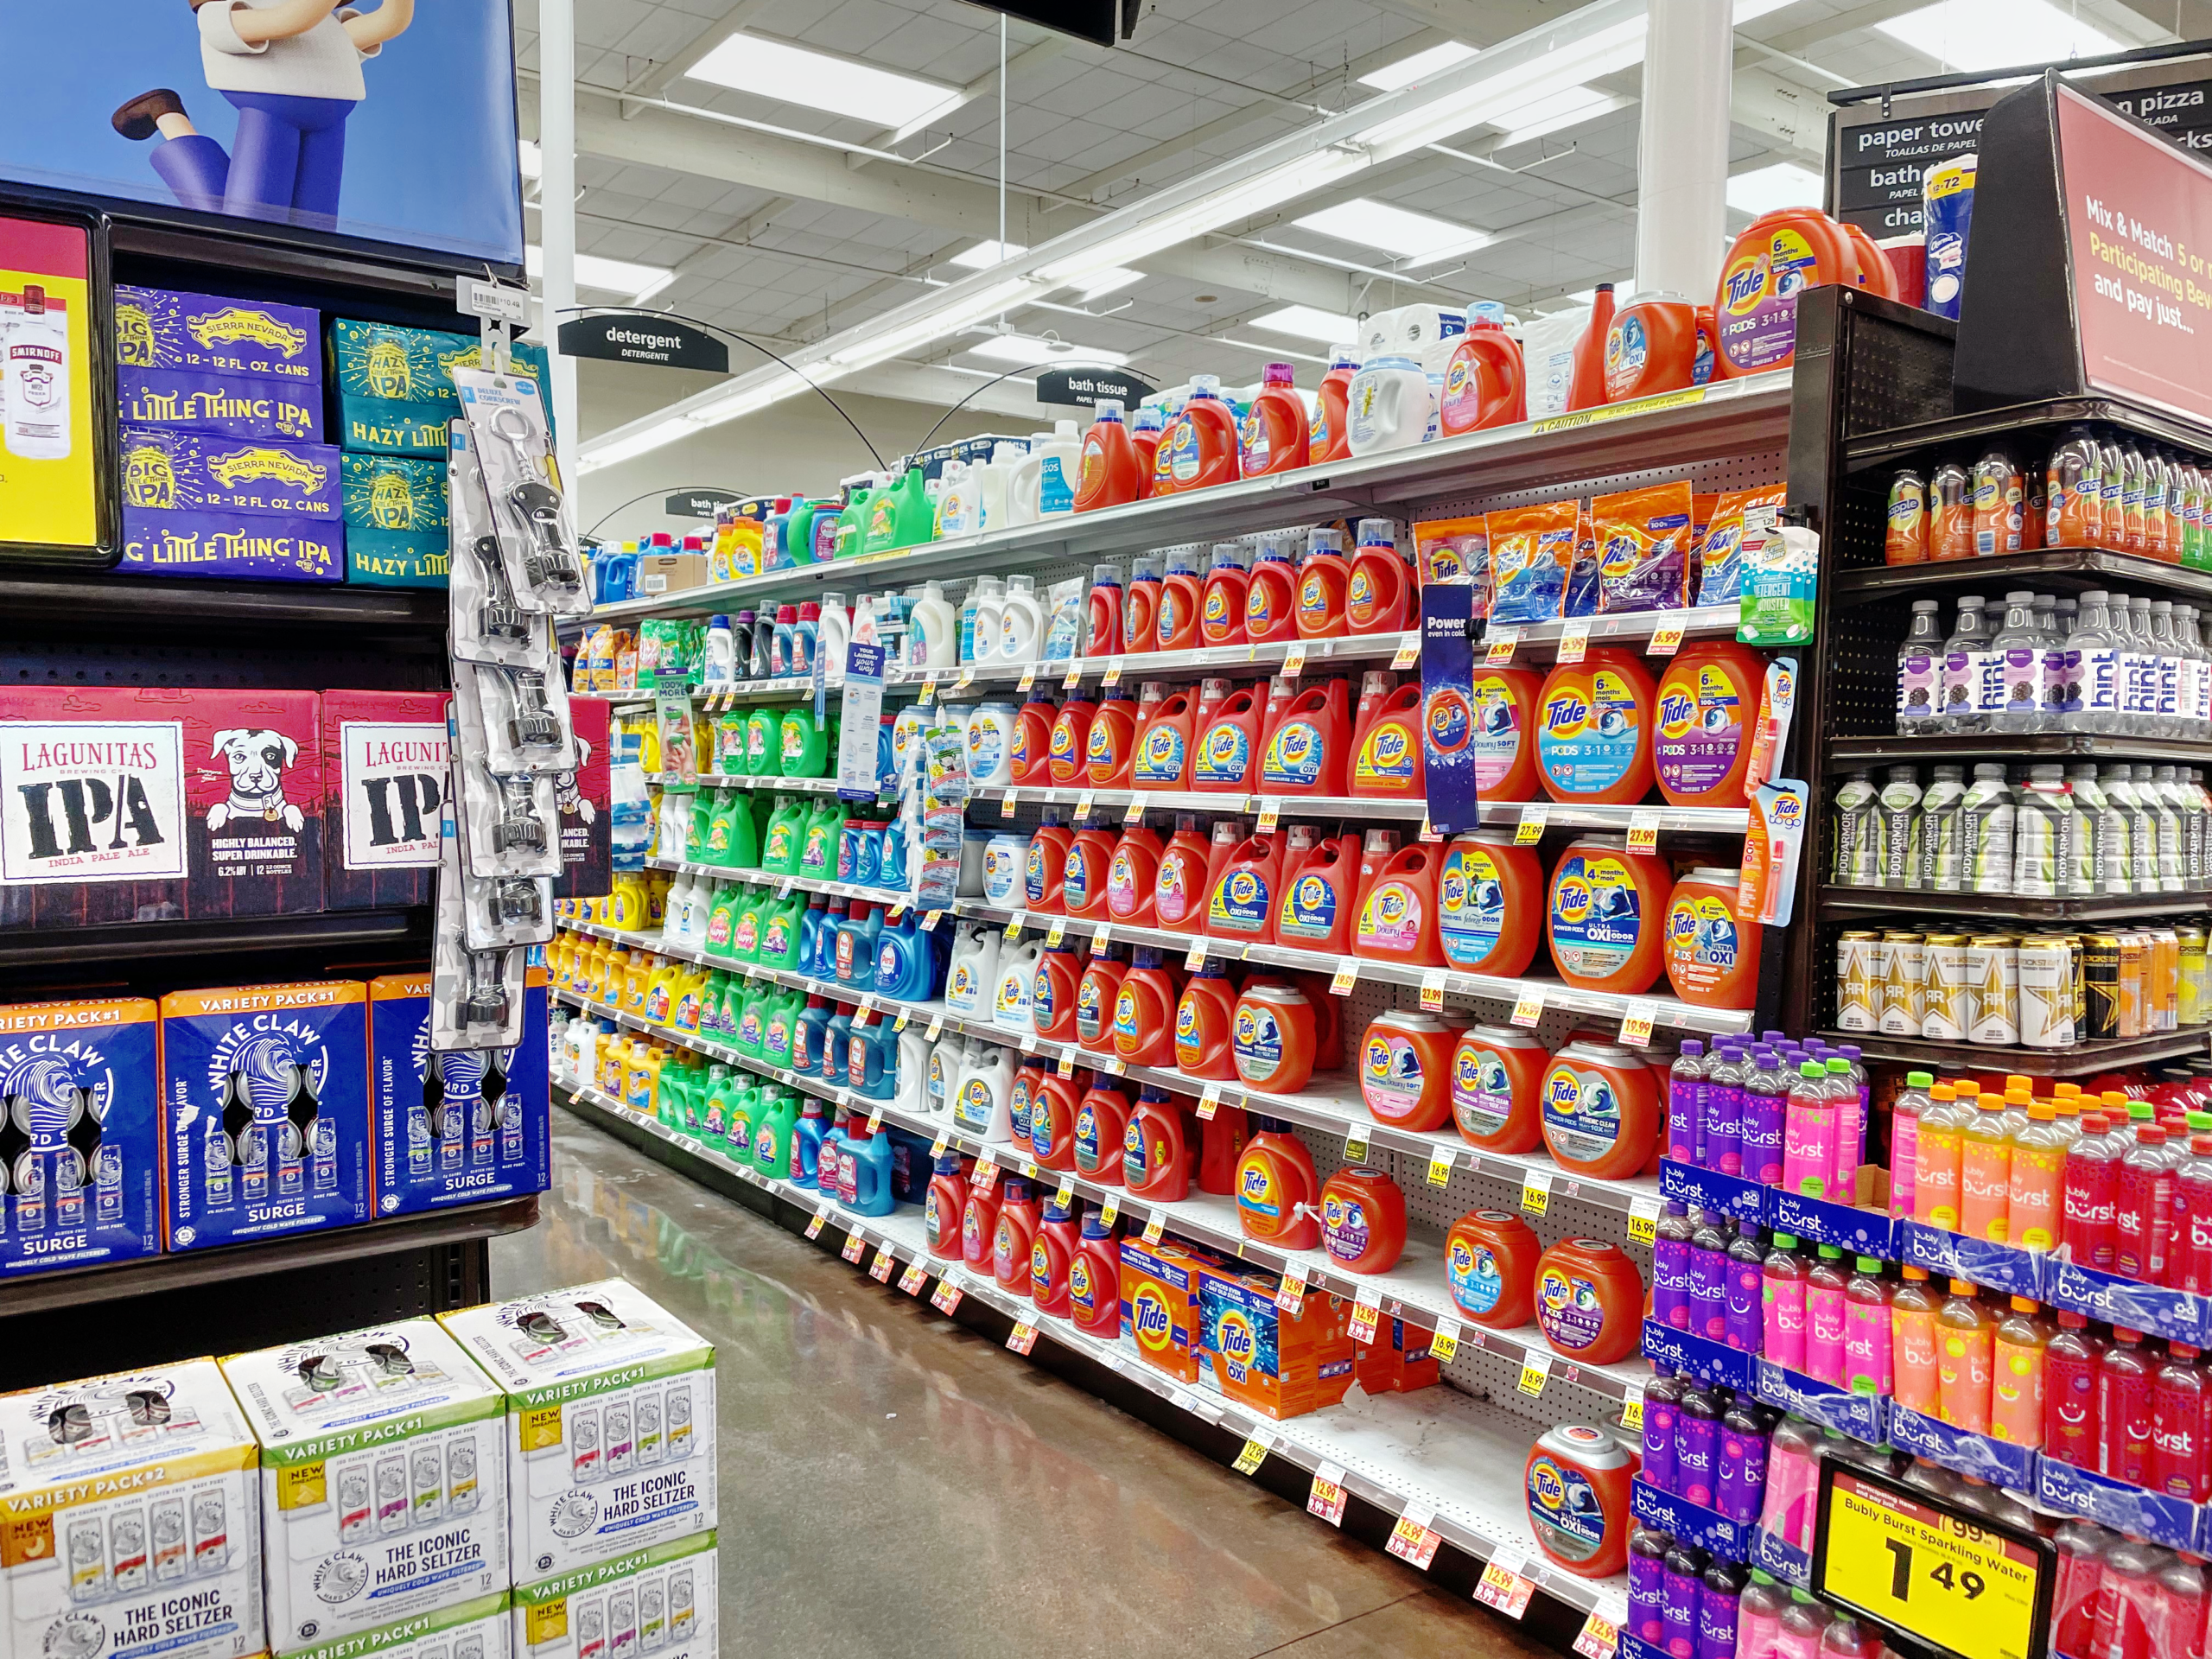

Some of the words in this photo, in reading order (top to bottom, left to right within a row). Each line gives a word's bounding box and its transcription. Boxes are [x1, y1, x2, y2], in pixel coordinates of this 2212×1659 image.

[2140, 90, 2204, 117] pizza
[1859, 125, 1924, 152] paper
[1885, 144, 1929, 158] TOALLAS
[1931, 143, 1945, 152] DE
[1947, 139, 1977, 150] PAPEL
[1870, 164, 1921, 188] bath
[1943, 177, 1959, 188] 72
[1888, 188, 1919, 199] PAPEL
[2086, 195, 2113, 230] Mix
[2116, 212, 2127, 238] &
[2131, 218, 2174, 261] Match
[2177, 247, 2187, 267] 5
[2190, 254, 2204, 274] or
[1773, 247, 1799, 257] months
[2089, 232, 2183, 302] Participating
[1726, 270, 1764, 312] Tide
[2094, 274, 2124, 305] and
[2127, 290, 2152, 321] pay
[2157, 298, 2195, 334] just...
[206, 321, 244, 334] SIERRA
[247, 323, 289, 342] NEVADA
[1729, 317, 1756, 335] PODS
[606, 327, 682, 350] detergent
[11, 347, 60, 362] SMIRNOFF
[621, 349, 669, 361] DETERGENTE
[187, 353, 200, 365] 12
[213, 356, 226, 367] 12
[275, 364, 309, 377] CANS
[1068, 377, 1095, 391] bath
[1096, 380, 1128, 396] tissue
[132, 390, 198, 420] LITTLE
[201, 388, 270, 418] THING
[277, 403, 313, 429] IPA
[479, 395, 520, 404] CORKSCREW
[1076, 395, 1093, 404] PAPEL
[1548, 414, 1592, 430] CAUTION
[353, 421, 405, 446] HAZY
[130, 461, 168, 477] BIG
[130, 482, 171, 505] IPA
[690, 498, 711, 509] bath
[1763, 518, 1775, 526] 1.29
[1754, 582, 1791, 598] DETERGENT
[1427, 616, 1466, 631] Power
[1451, 629, 1466, 638] cold.
[1654, 632, 1681, 644] 6.99
[854, 652, 879, 660] LAUNDRY
[854, 658, 875, 667] your
[1285, 657, 1303, 669] 6.99
[857, 664, 875, 675] way
[2090, 648, 2114, 709] hint
[658, 688, 686, 697] MORE
[660, 680, 684, 689] 100%
[2160, 656, 2177, 713] hint
[1548, 698, 1587, 728] Tide
[1659, 693, 1694, 726] Tide
[22, 742, 157, 771] LAGUNITAS
[1551, 745, 1579, 757] PODS
[17, 774, 165, 860] IPA
[1260, 812, 1277, 824] 19.99
[1769, 813, 1782, 827] to
[1783, 816, 1801, 830] go
[1519, 823, 1542, 837] 27.99
[212, 838, 246, 849] HIGHLY
[248, 836, 297, 847] BALANCED.
[1890, 811, 1903, 878] BODYARMOR
[1924, 814, 1933, 879] BODYARMOR
[48, 856, 84, 868] INDIA
[92, 850, 120, 863] PALE
[128, 848, 150, 858] ALE
[213, 850, 243, 861] SUPER
[245, 849, 297, 860] DRINKABLE.
[1559, 887, 1589, 913] Tide
[1376, 924, 1401, 938] Downy
[1672, 913, 1696, 938] Tide
[1587, 928, 1611, 942] OXI
[1710, 950, 1732, 965] OXI
[200, 996, 270, 1012] VARIETY
[1624, 1018, 1652, 1034] 19.99
[209, 1023, 251, 1090] WHITE
[252, 1014, 321, 1046] CLAW
[384, 1096, 393, 1106] OF
[384, 1141, 395, 1186] STRONGER
[445, 1173, 495, 1191] SURGE
[1524, 1191, 1547, 1205] 16.99
[248, 1202, 306, 1223] SURGE
[1630, 1218, 1655, 1236] 16.99
[1640, 1236, 1654, 1245] PRICE
[1129, 1249, 1150, 1262] PROTECTS
[1209, 1280, 1228, 1291] ATTACKS
[1229, 1287, 1241, 1296] EVEN
[1281, 1277, 1303, 1294] 12.99
[1276, 1294, 1291, 1307] 9.99
[1136, 1298, 1168, 1332] Tide
[1222, 1325, 1251, 1354] Tide
[1227, 1365, 1247, 1383] OXI
[526, 1379, 590, 1404] VARIETY
[531, 1408, 560, 1424] NEW
[531, 1417, 561, 1428] PINEAPPLE
[613, 1484, 638, 1502] THE
[641, 1471, 686, 1495] ICONIC
[1535, 1472, 1561, 1497] Tide
[604, 1500, 639, 1521] HARD
[644, 1485, 695, 1510] SELTZER
[1856, 1482, 1897, 1505] participating
[1898, 1499, 1917, 1511] items
[1856, 1489, 1868, 1499] and
[1869, 1494, 1881, 1504] pay
[1845, 1497, 1879, 1522] Bubly
[1884, 1513, 1916, 1536] Burst
[1920, 1529, 1981, 1565] Sparkling
[1986, 1557, 2028, 1583] Water
[1487, 1567, 1514, 1587] 12.99
[1885, 1536, 1913, 1603] 1
[1930, 1561, 1985, 1600] 49
